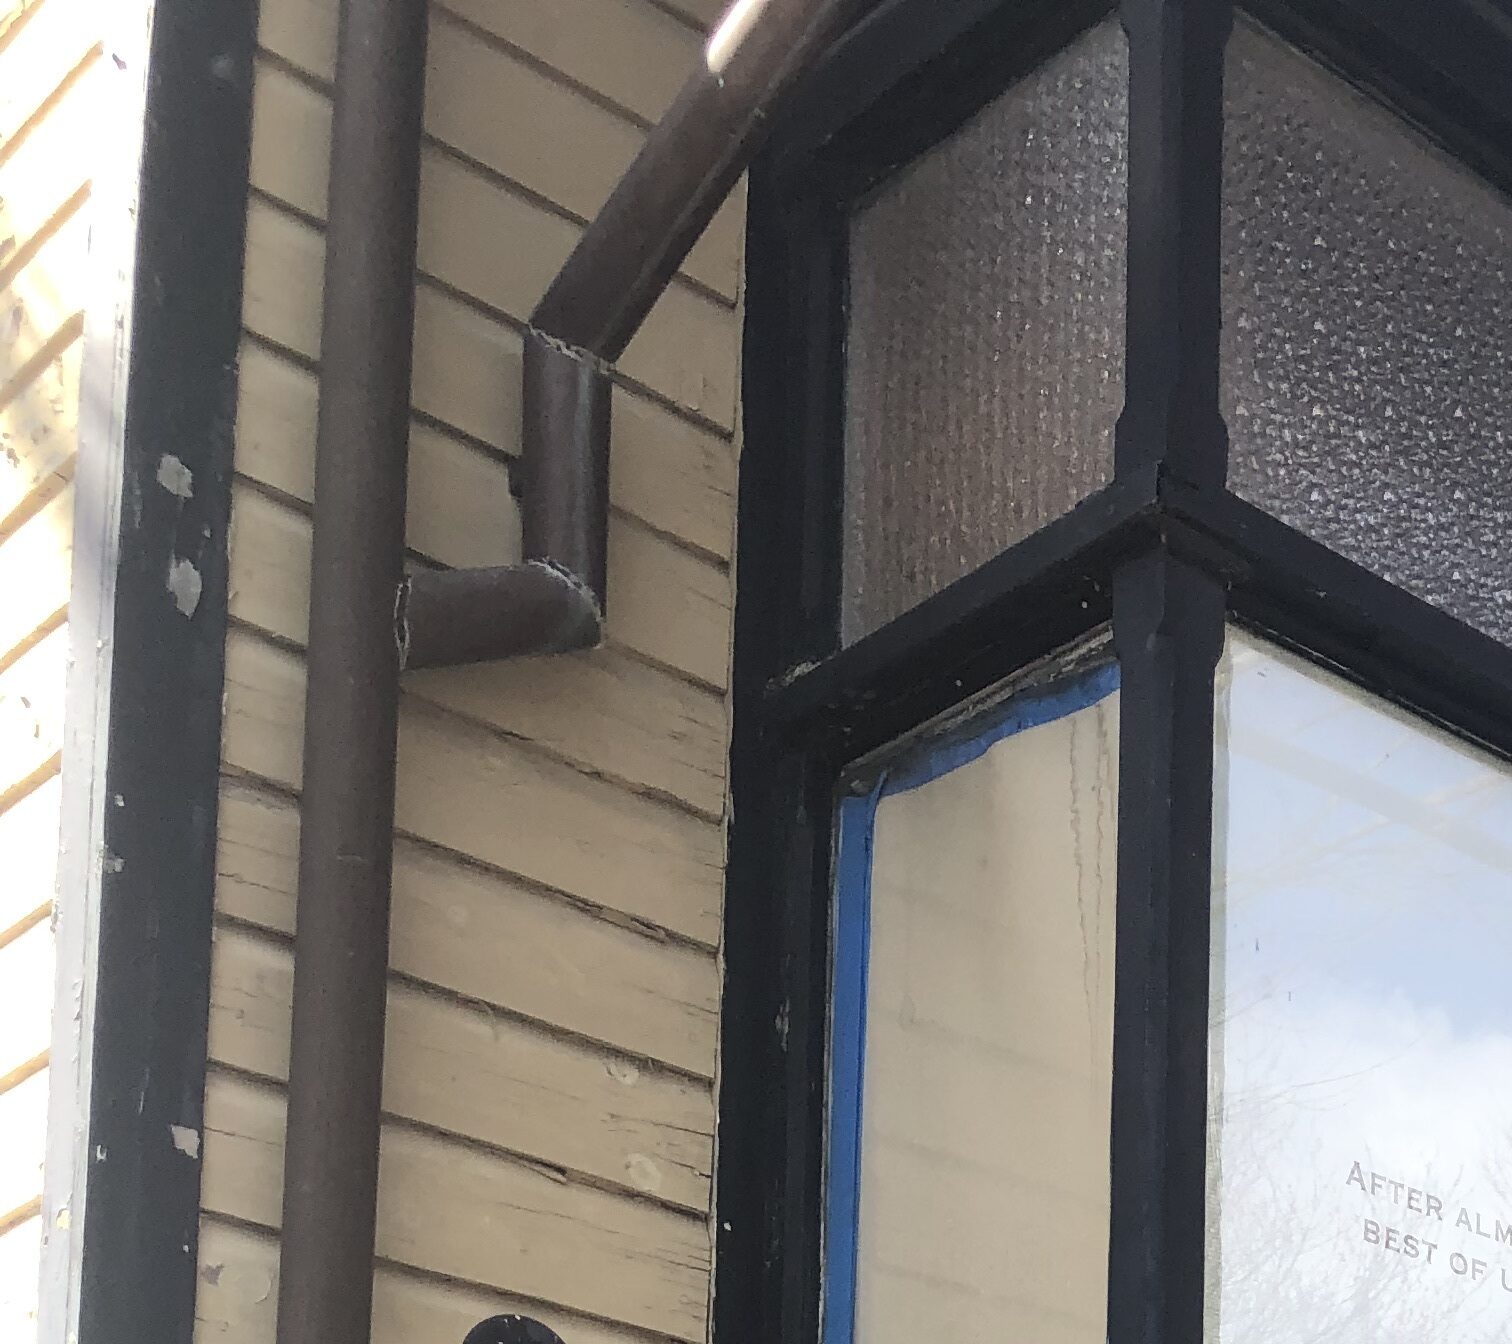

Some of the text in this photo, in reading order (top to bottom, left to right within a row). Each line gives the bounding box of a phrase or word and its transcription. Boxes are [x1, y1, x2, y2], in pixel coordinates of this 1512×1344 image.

[1346, 1161, 1443, 1221] AFTER
[1362, 1219, 1438, 1265] BEST
[1449, 1252, 1488, 1281] OF
